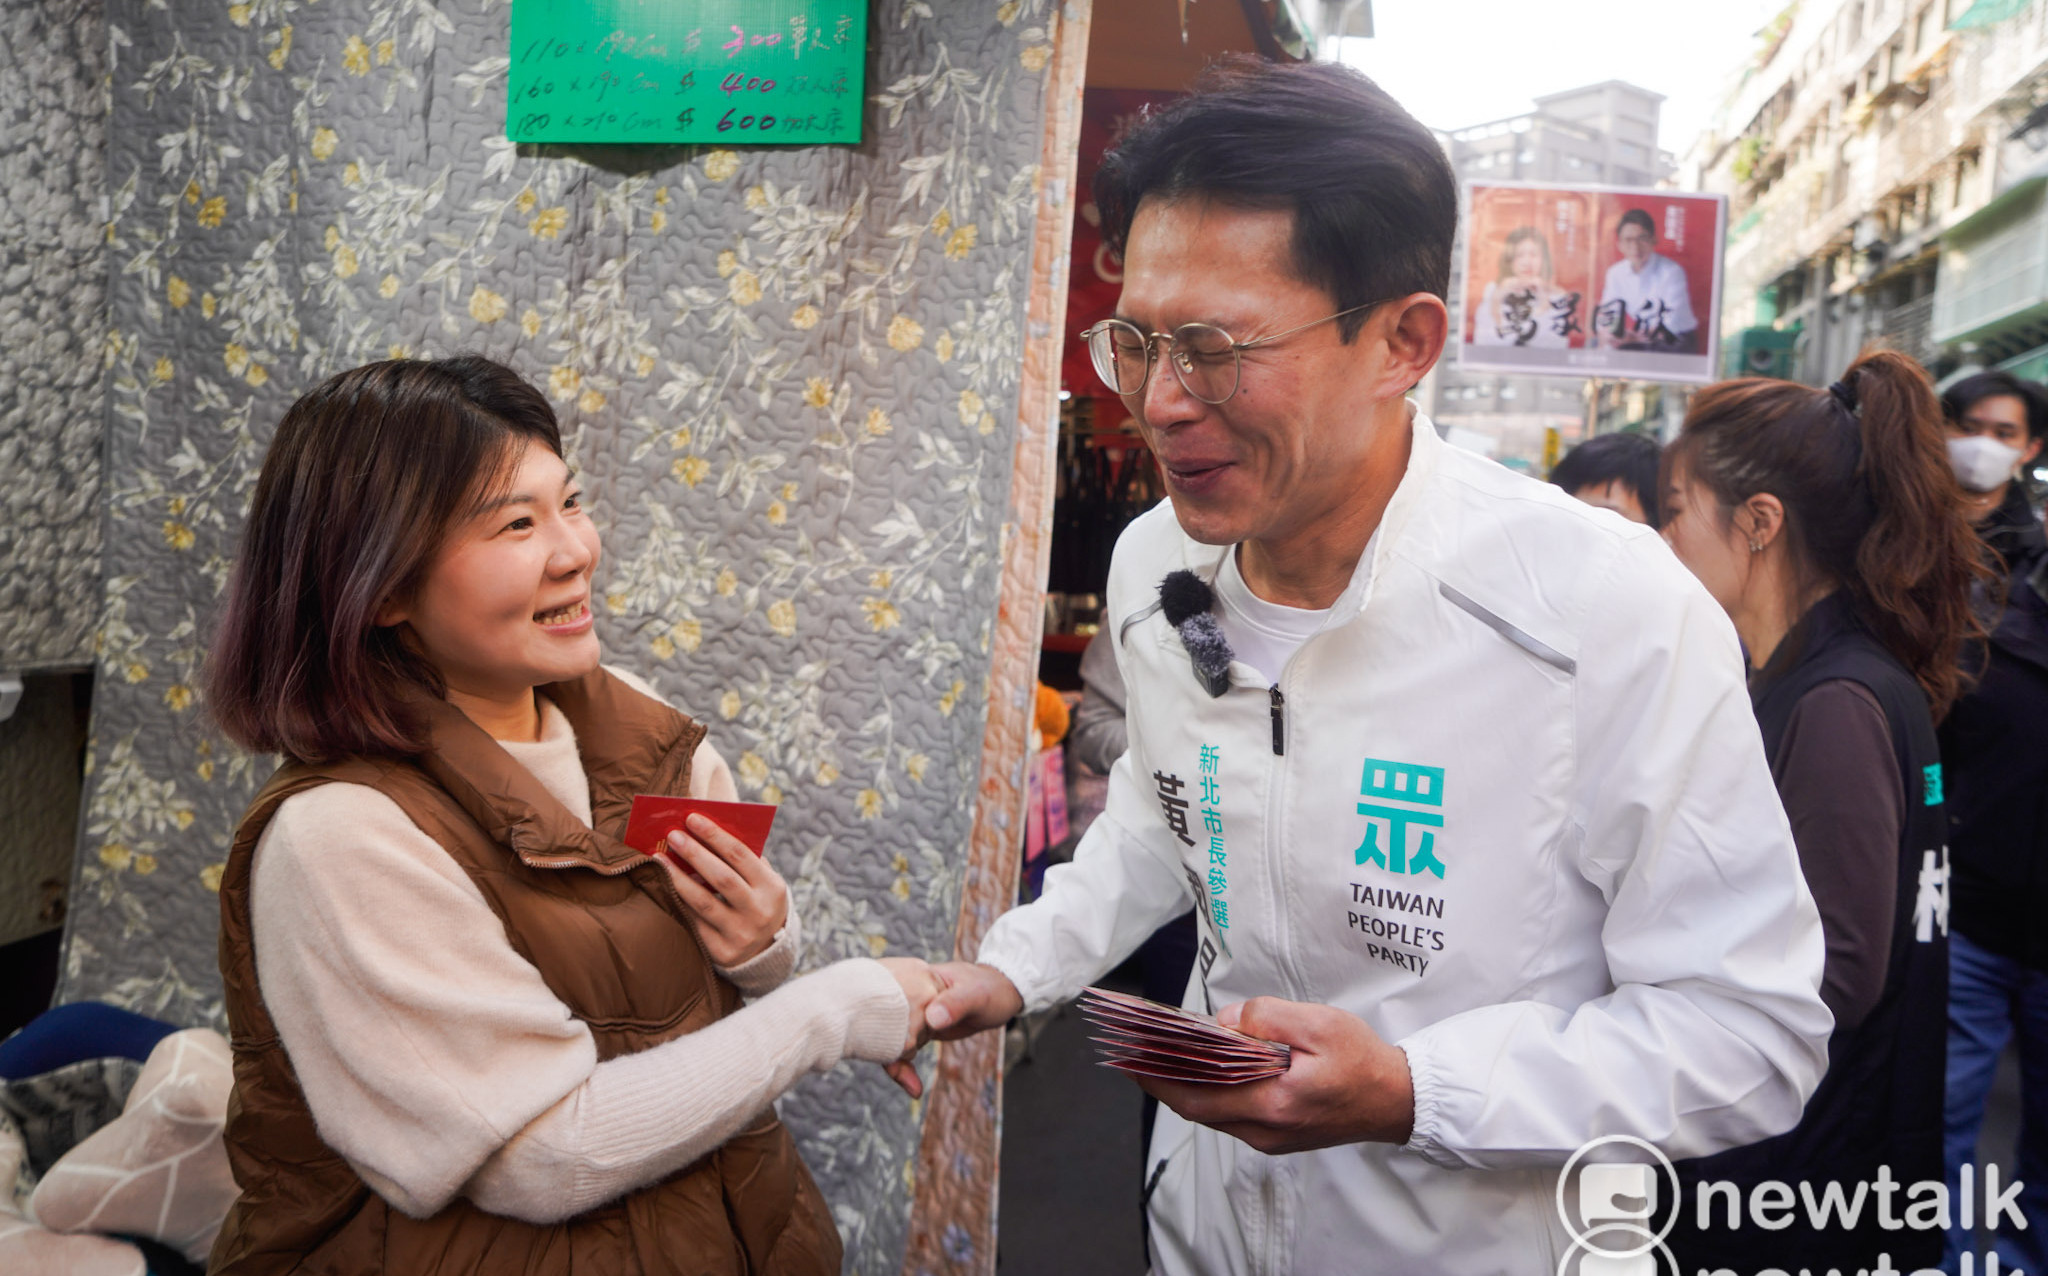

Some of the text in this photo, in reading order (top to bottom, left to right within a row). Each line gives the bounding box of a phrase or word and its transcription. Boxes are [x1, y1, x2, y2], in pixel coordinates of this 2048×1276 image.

[520, 37, 569, 63] 110
[722, 24, 783, 59] 300
[514, 76, 554, 103] 160
[720, 72, 777, 97] 400
[515, 113, 550, 137] 180
[717, 108, 777, 132] 600
[1355, 758, 1446, 880] 眾
[1350, 882, 1445, 919] TAIWAN
[1347, 910, 1445, 952] PEOPLE'S
[1366, 941, 1430, 978] PARTY
